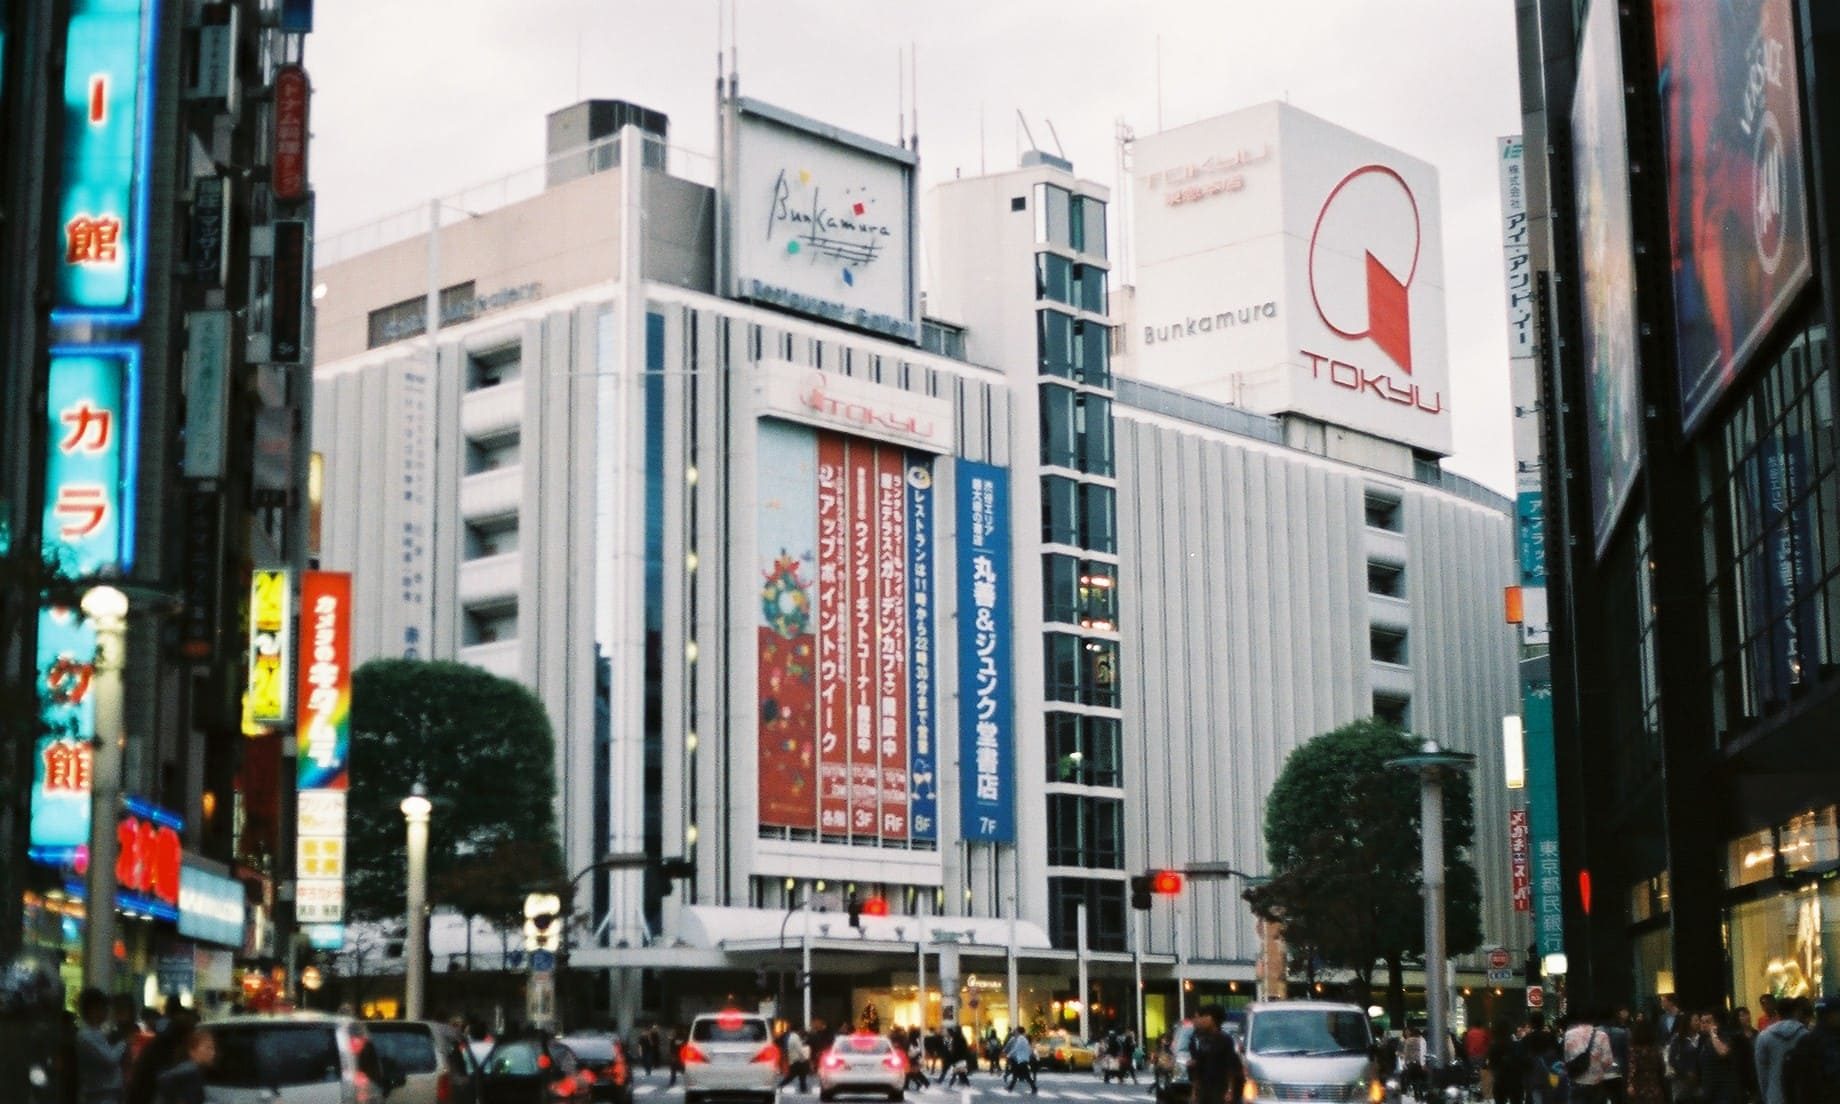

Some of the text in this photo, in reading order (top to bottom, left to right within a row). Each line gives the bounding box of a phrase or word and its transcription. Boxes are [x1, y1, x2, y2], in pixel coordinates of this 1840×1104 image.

[766, 168, 891, 241] Bunkamura
[1144, 301, 1278, 345] Bunkamura
[1300, 349, 1441, 414] TOKYU
[822, 396, 933, 438] TOKYU
[855, 808, 873, 828] 3F
[884, 813, 904, 833] RF
[979, 816, 997, 835] 7F
[1539, 839, 1563, 952] 東京都民銀行
